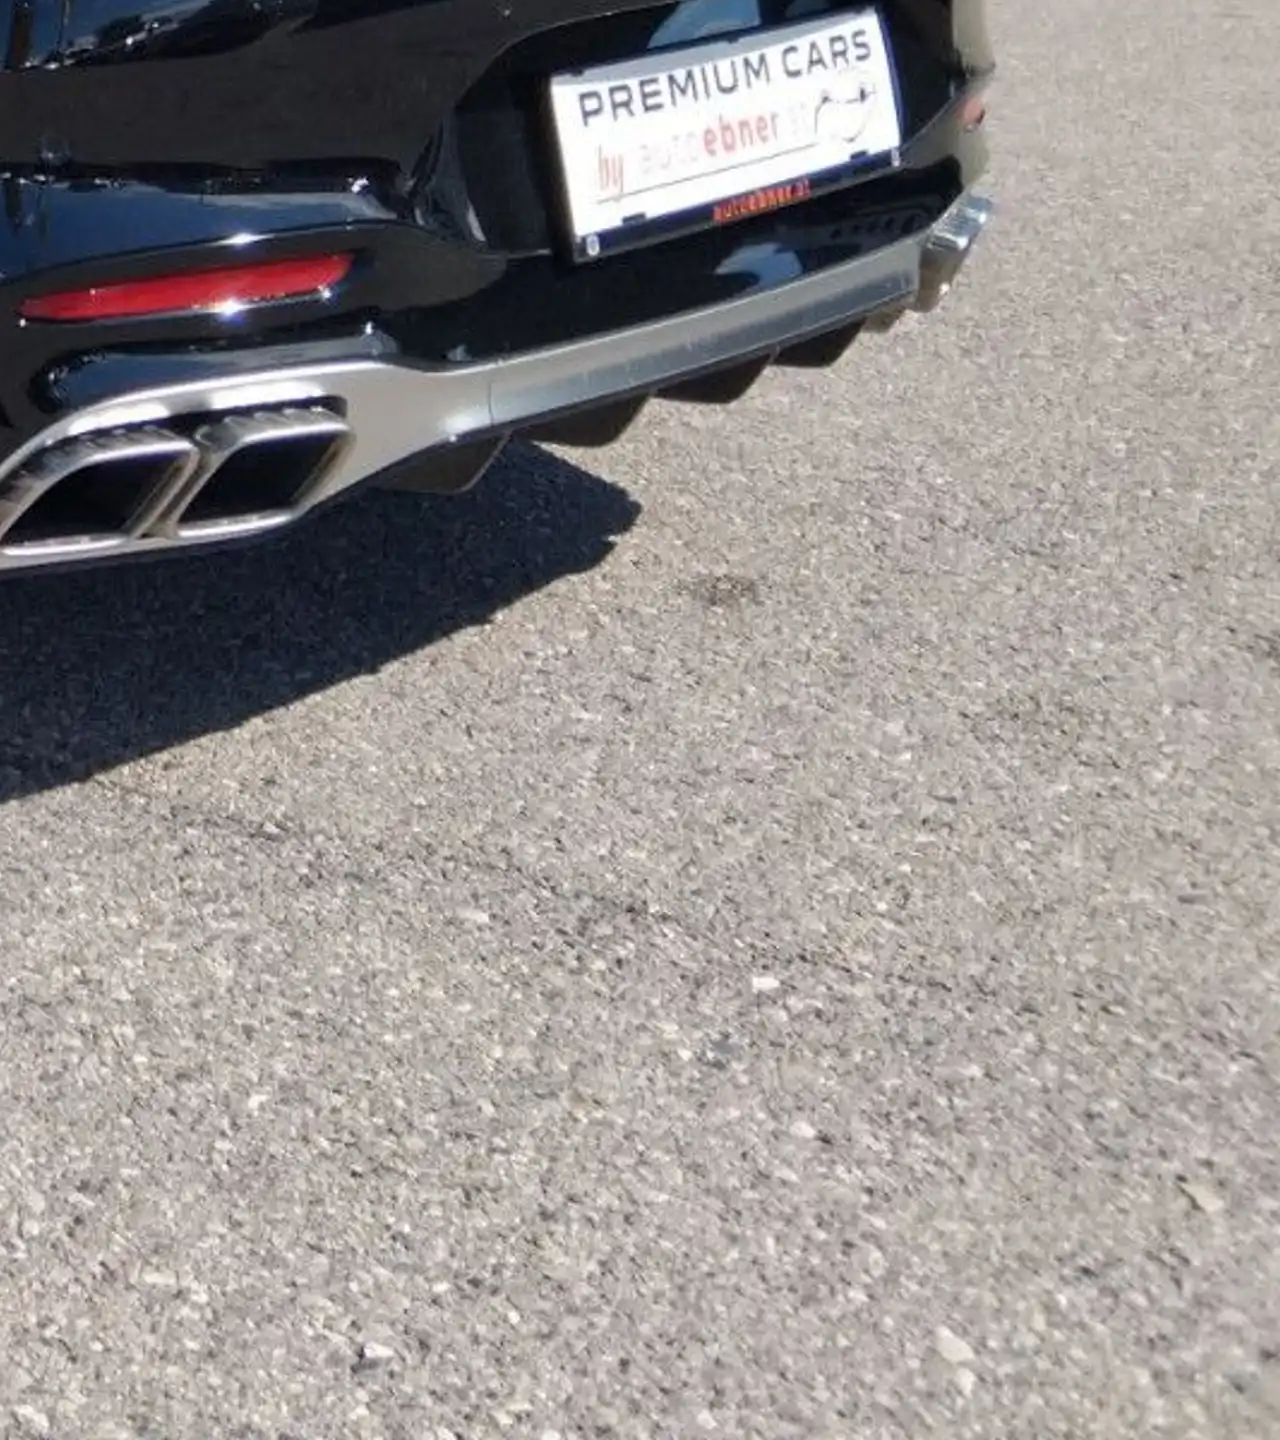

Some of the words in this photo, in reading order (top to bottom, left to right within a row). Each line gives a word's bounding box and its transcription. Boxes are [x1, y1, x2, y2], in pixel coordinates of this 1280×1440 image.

[577, 52, 771, 128] PREMIUM
[780, 28, 871, 78] CARS
[597, 143, 625, 203] by
